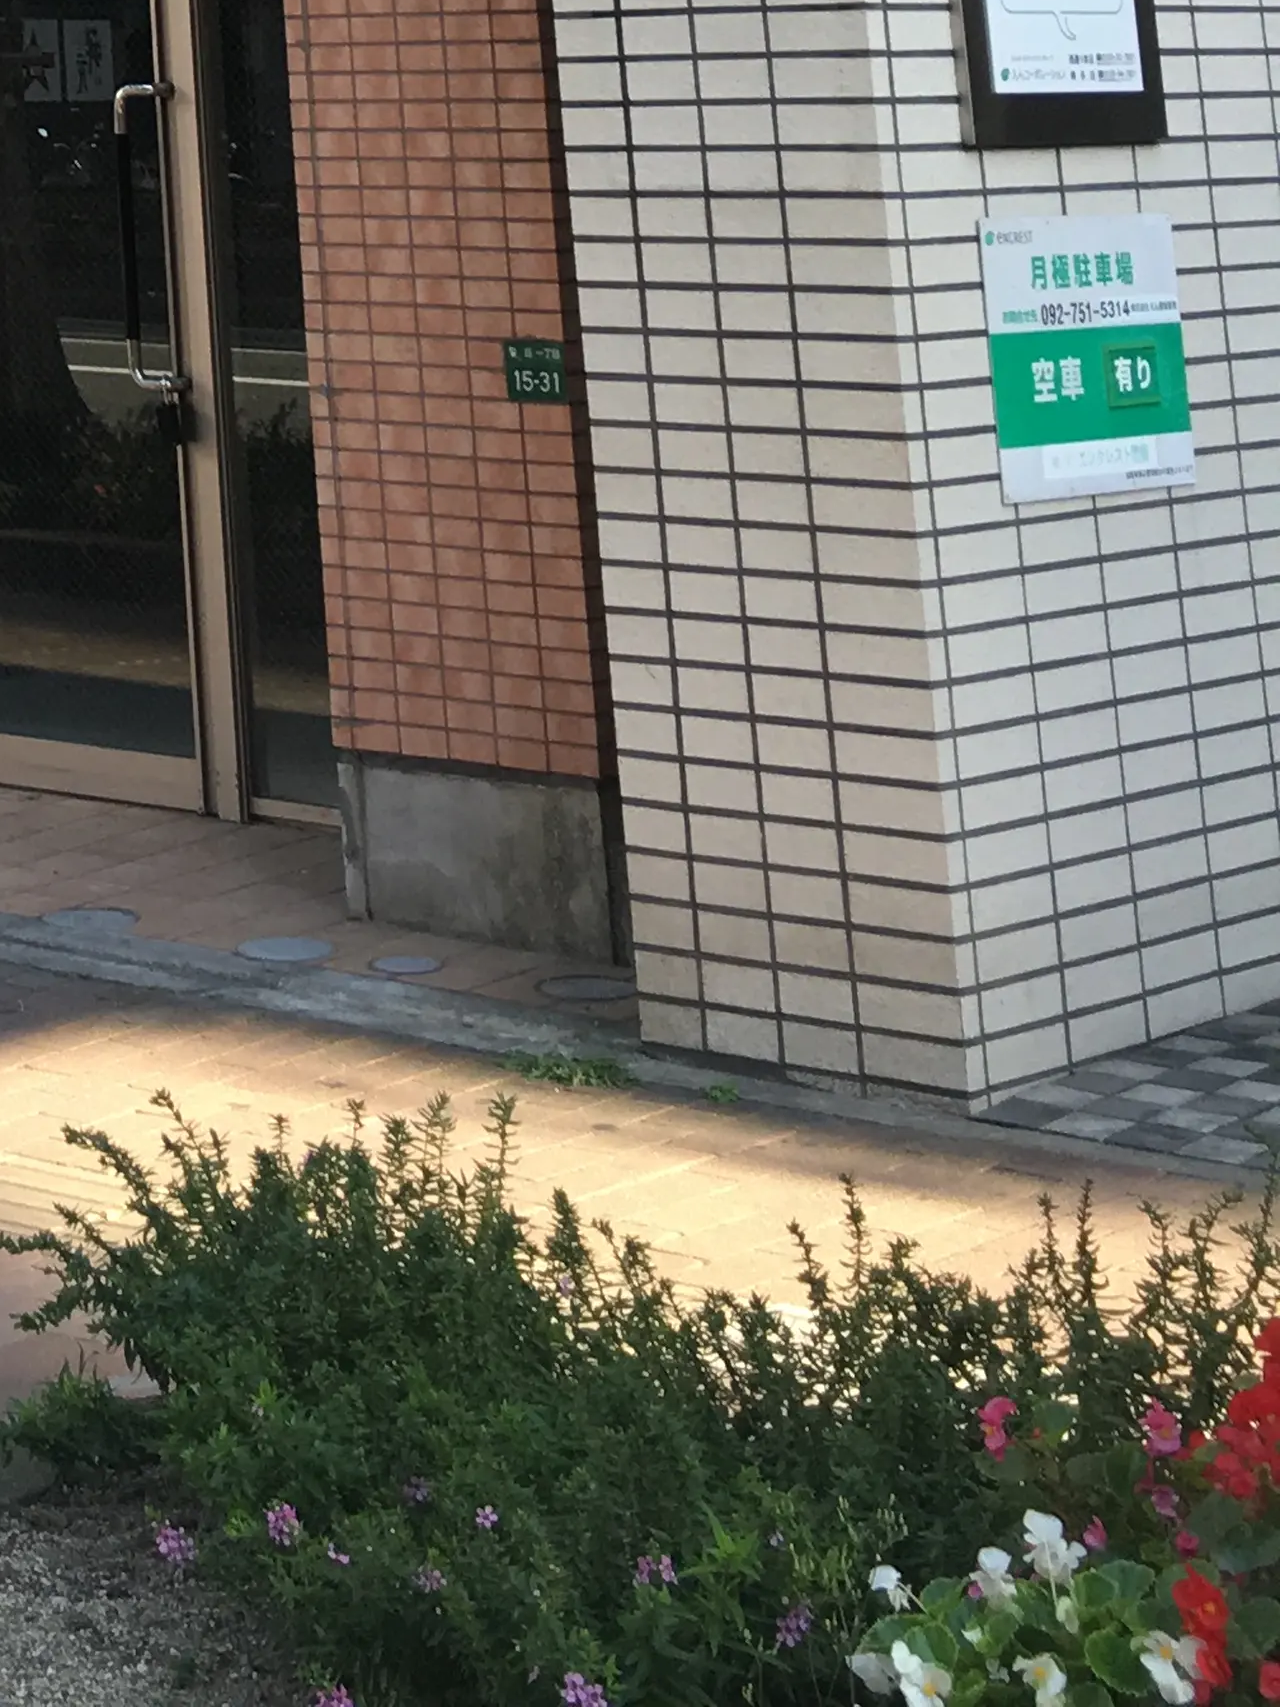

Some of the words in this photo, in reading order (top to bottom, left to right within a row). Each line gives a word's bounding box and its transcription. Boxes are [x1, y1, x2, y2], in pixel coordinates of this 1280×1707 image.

[1030, 251, 1134, 291] 月極駐車場
[1040, 300, 1131, 326] 092-751-5314
[513, 369, 560, 394] 15-31
[1030, 355, 1086, 404] 空車
[1113, 355, 1152, 393] 有り
